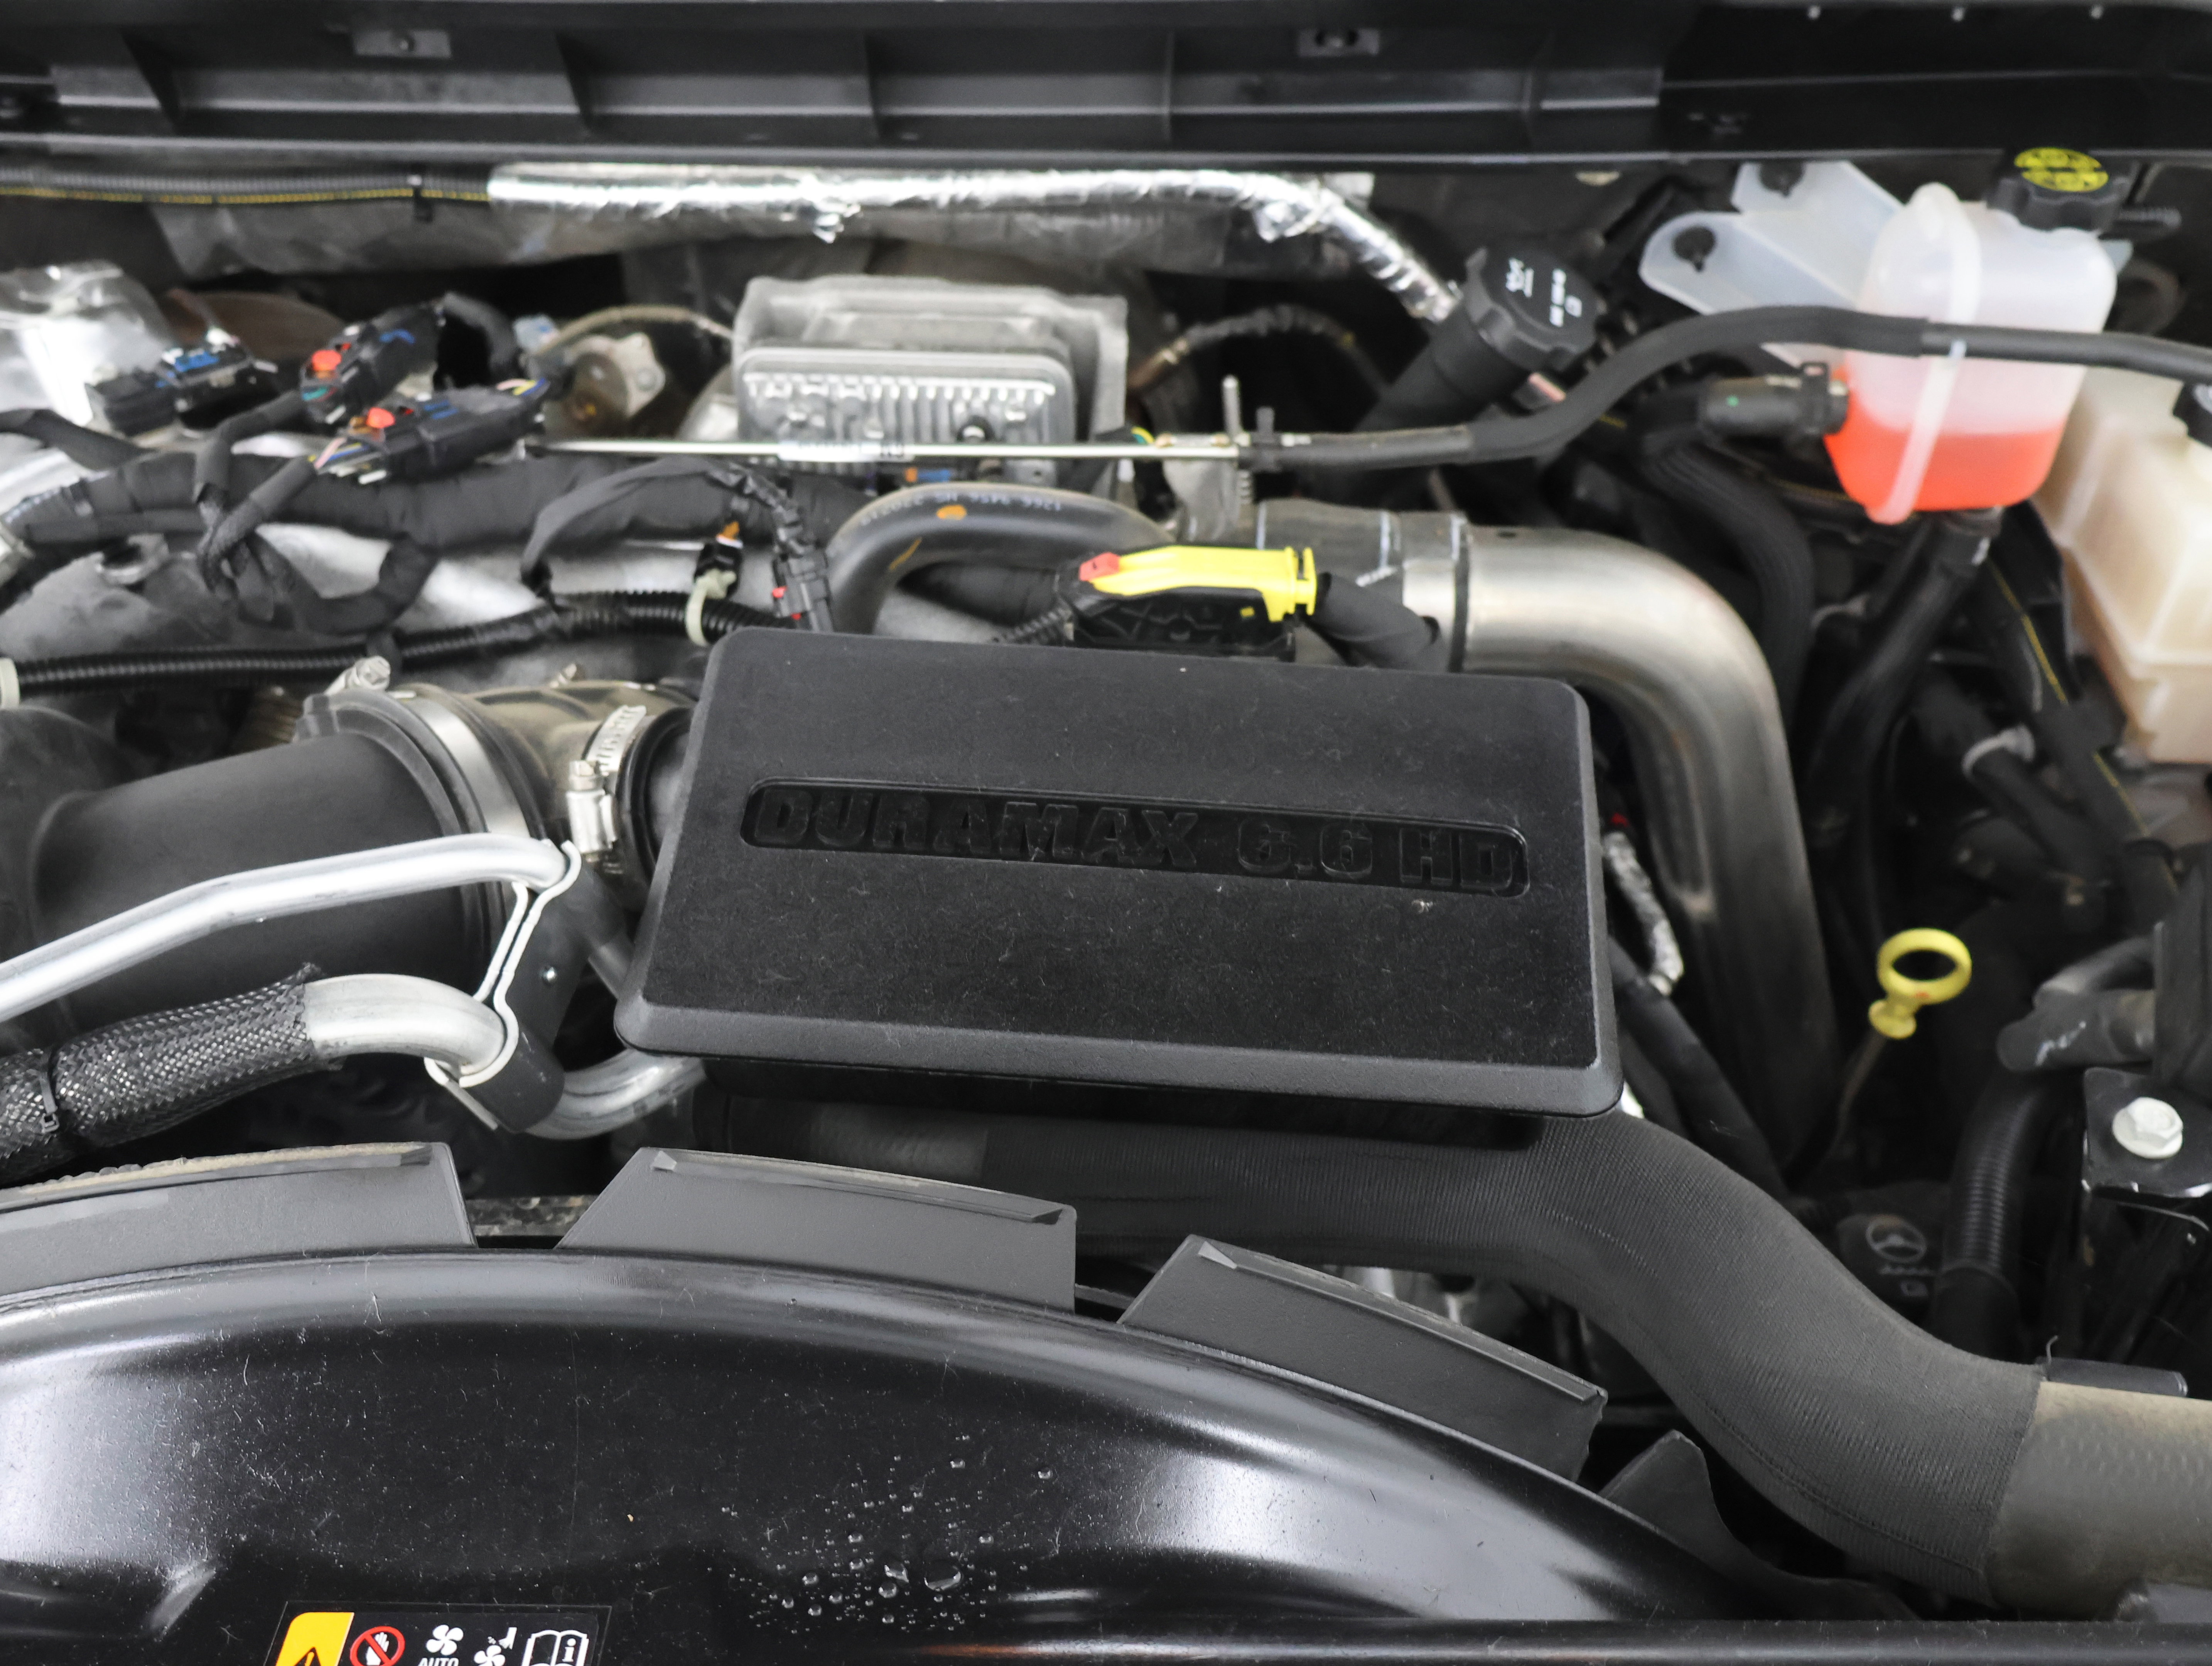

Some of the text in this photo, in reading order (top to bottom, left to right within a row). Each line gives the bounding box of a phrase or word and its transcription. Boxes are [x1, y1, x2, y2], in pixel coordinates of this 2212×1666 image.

[754, 787, 1515, 887] DURAMAX 6.6 HD
[417, 1657, 459, 1666] AUTO
